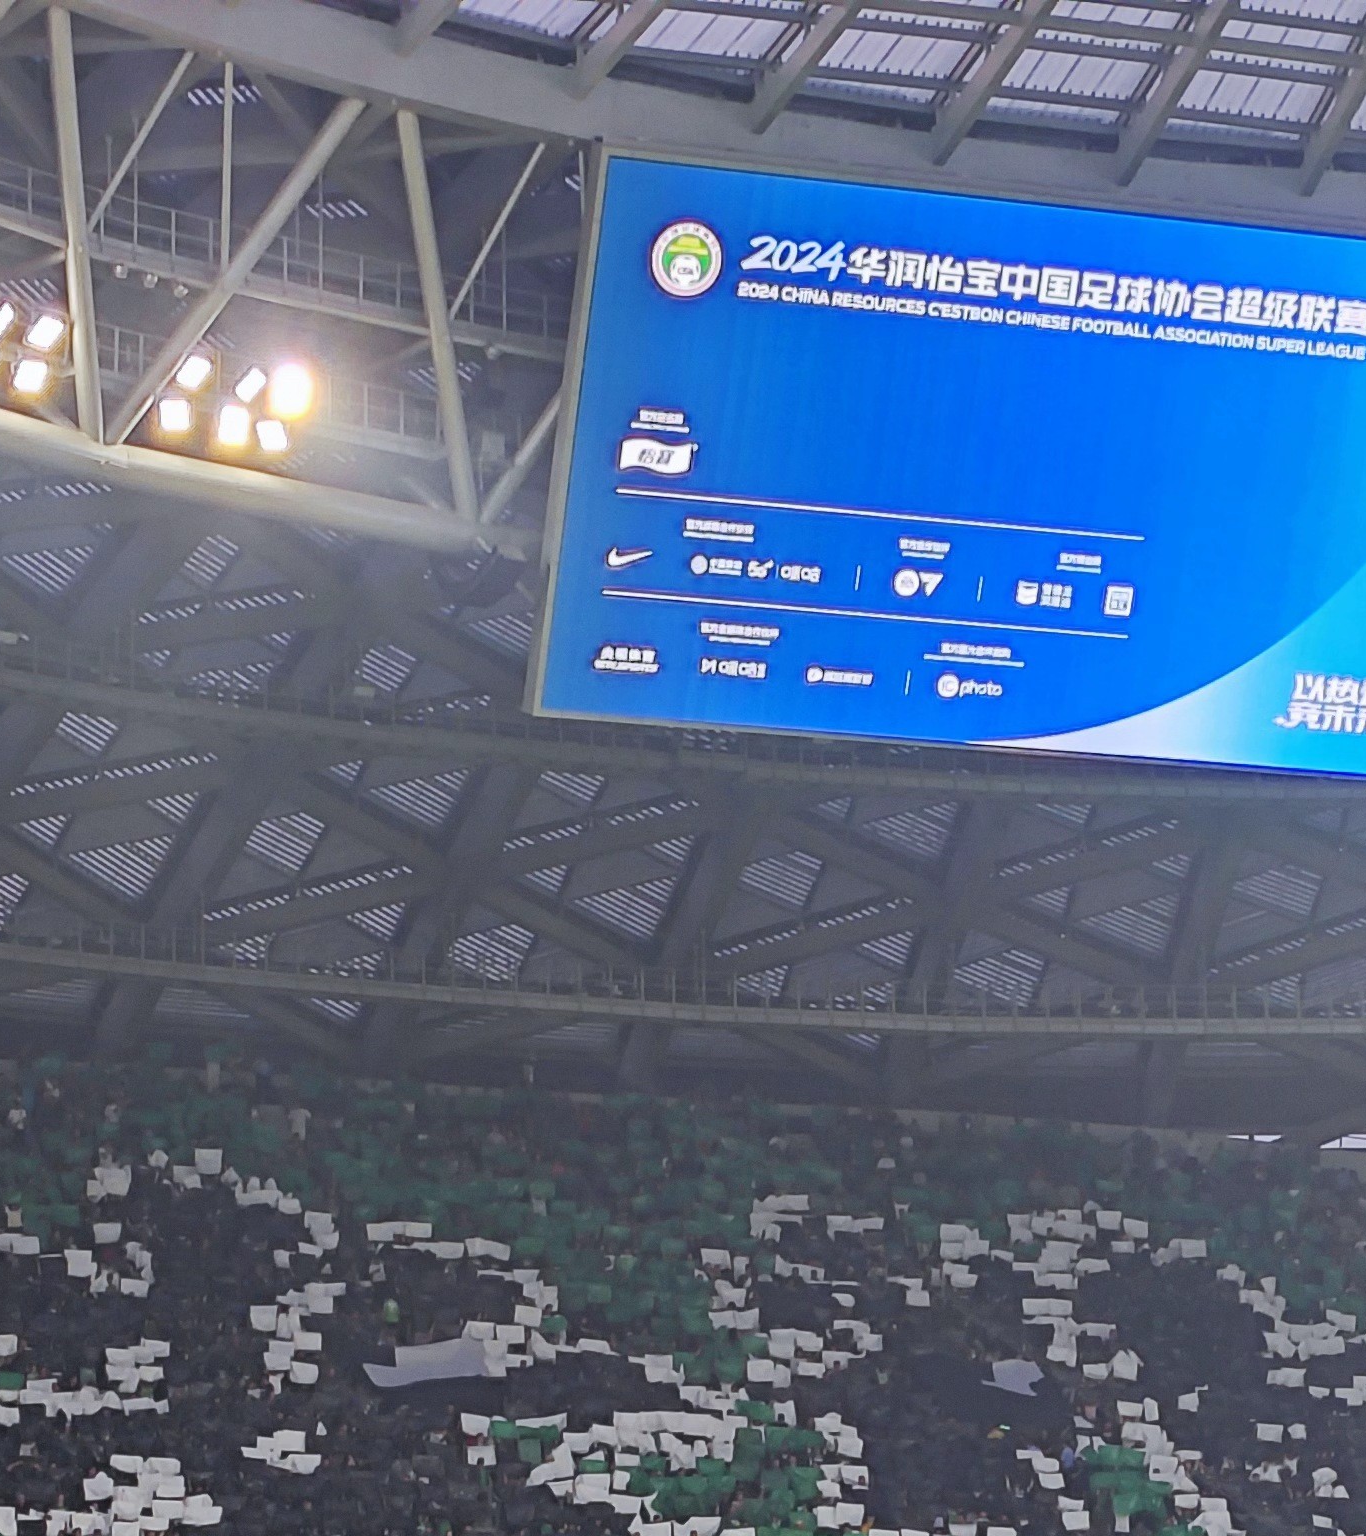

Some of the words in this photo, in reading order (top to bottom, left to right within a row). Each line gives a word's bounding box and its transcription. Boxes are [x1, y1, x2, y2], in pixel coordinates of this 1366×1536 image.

[737, 281, 778, 300] 2024
[781, 286, 829, 306] CHINA
[832, 291, 926, 315] RESOURCES
[1005, 308, 1070, 330] CHINESE
[1072, 317, 1151, 339] FOOTBALL
[1153, 325, 1254, 349] ASSOCIATION
[1256, 335, 1306, 354] SUPER
[1307, 341, 1366, 361] LEAGUE
